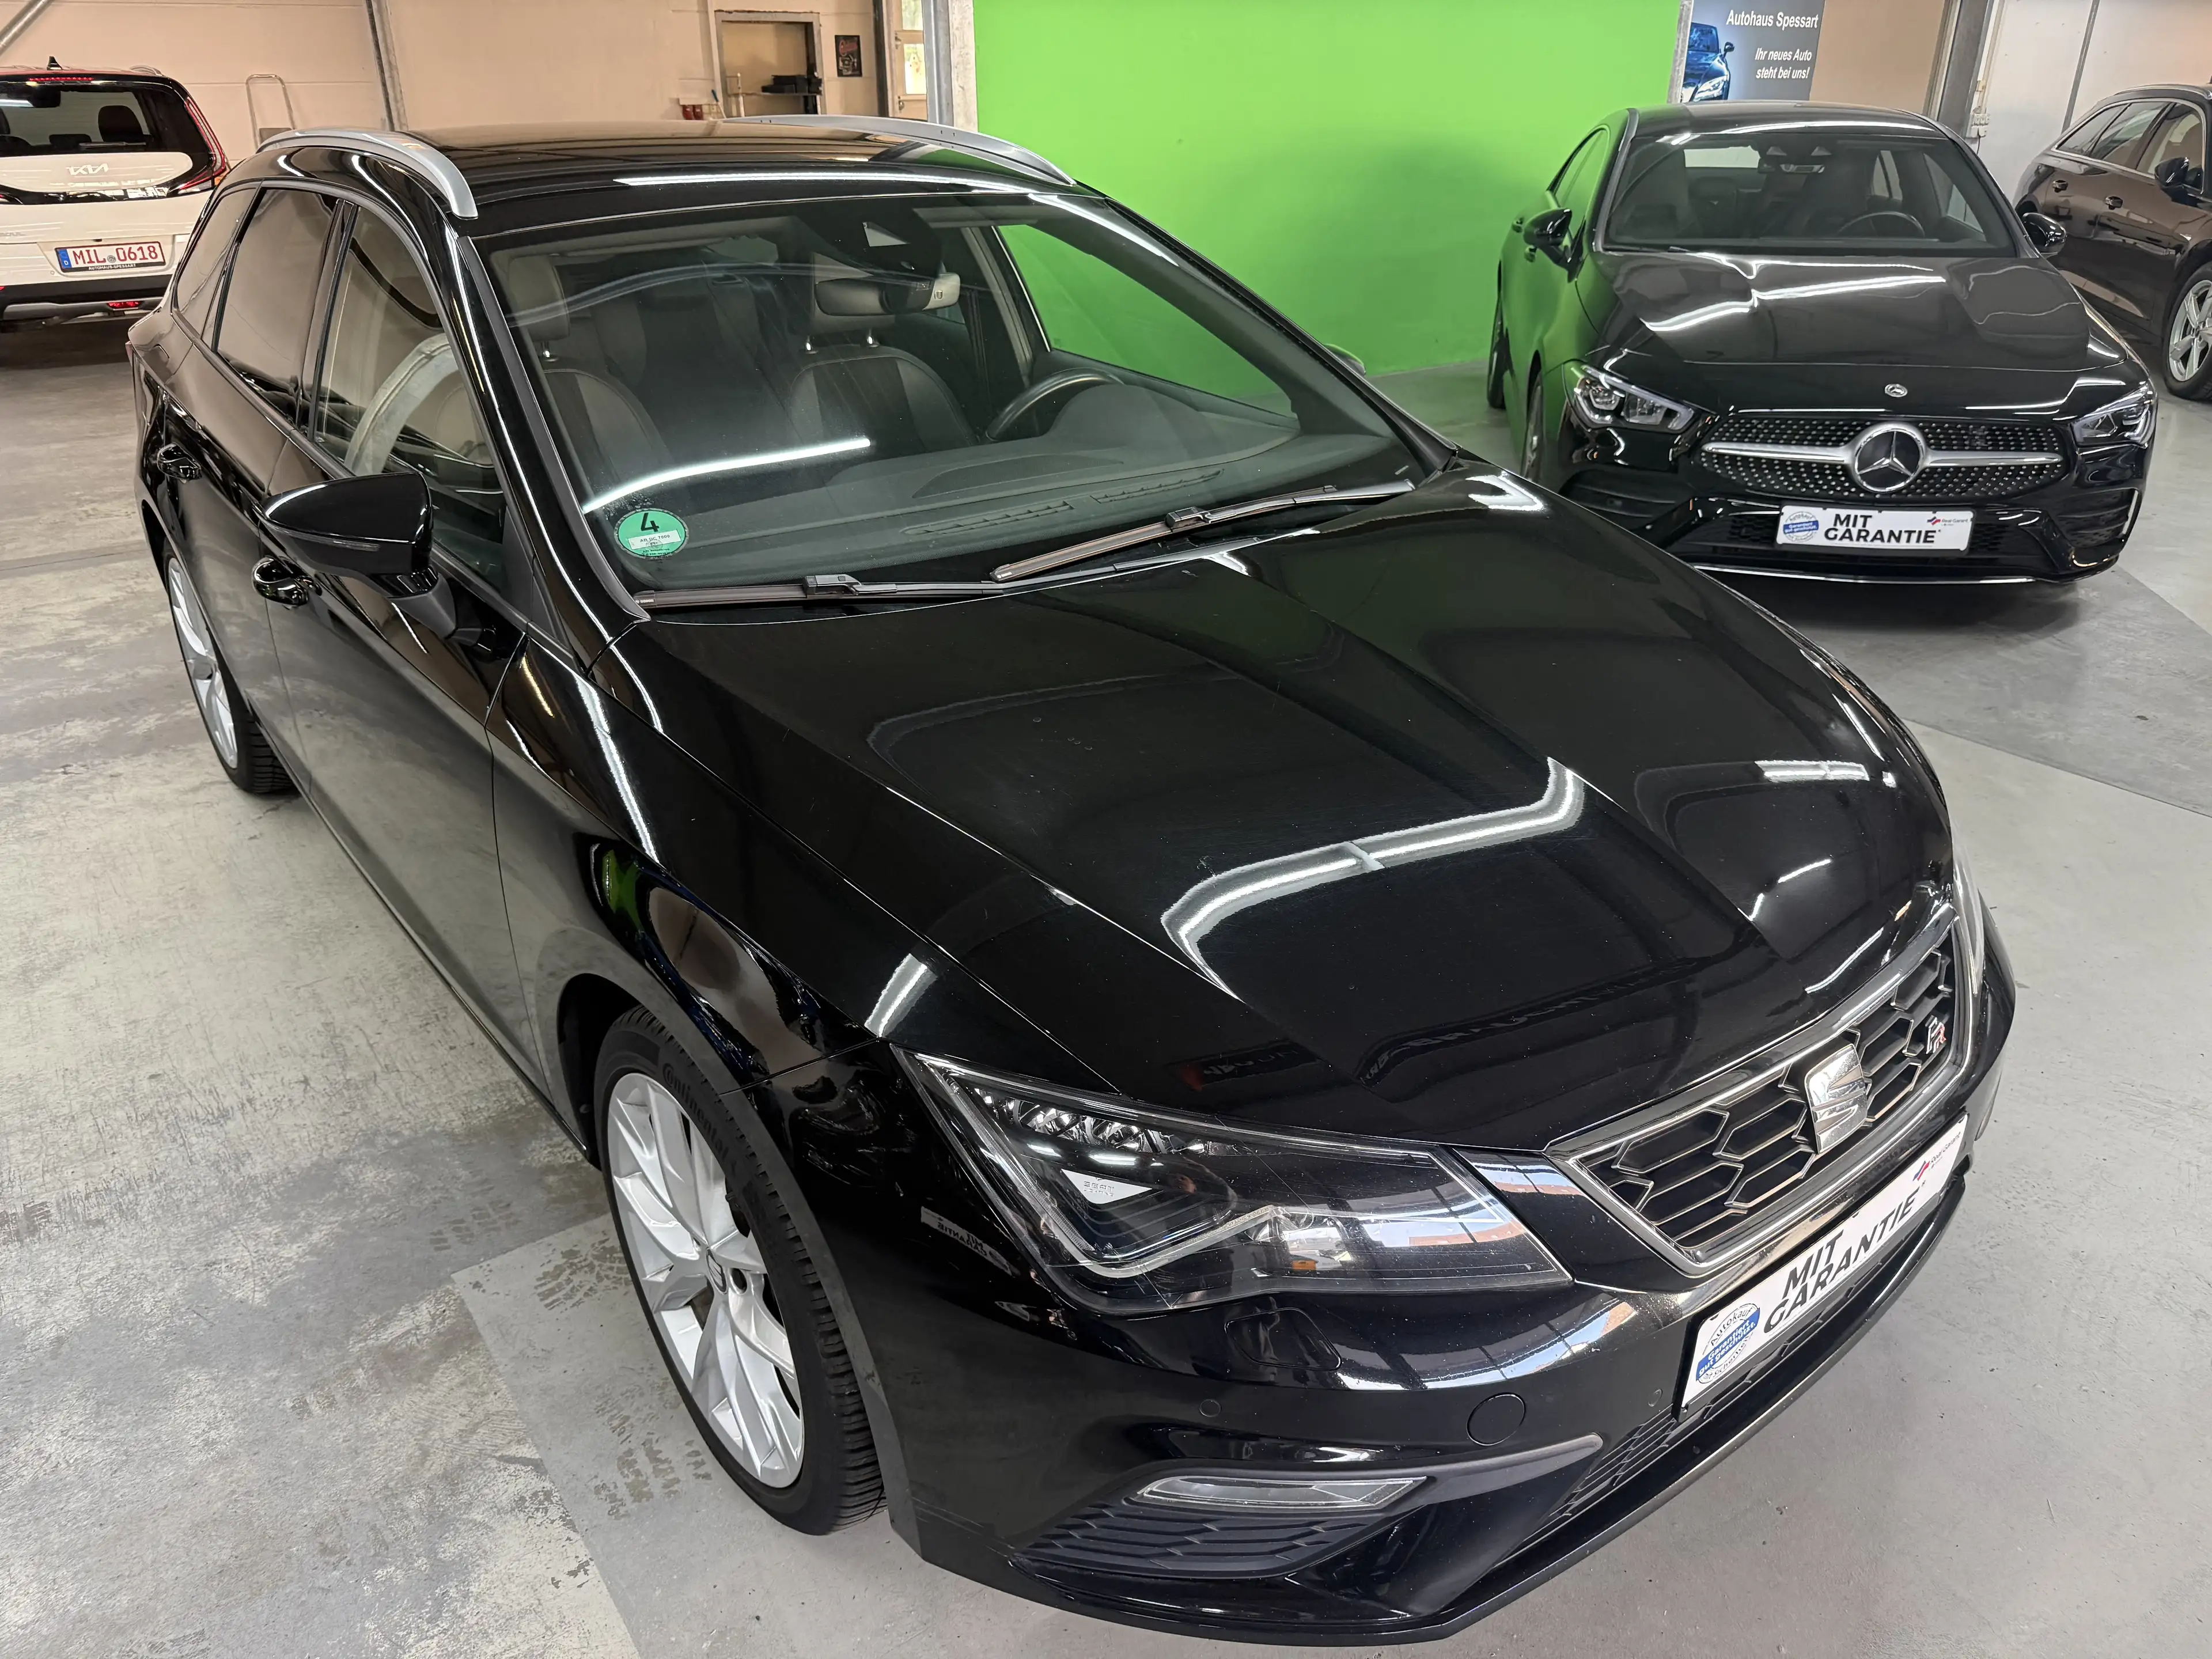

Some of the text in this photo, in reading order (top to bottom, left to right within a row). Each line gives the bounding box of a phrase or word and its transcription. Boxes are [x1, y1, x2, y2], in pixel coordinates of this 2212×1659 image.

[1726, 9, 1819, 31] Autohaus Spessart
[1755, 48, 1812, 61] Ihr neues Auto
[1756, 66, 1810, 79] steht bei uns!
[72, 245, 158, 265] MIL 0618
[641, 512, 660, 532] 4
[1833, 514, 1873, 528] MIT
[1782, 1229, 1844, 1300] MIT
[1710, 1307, 1753, 1346] Autokauf
